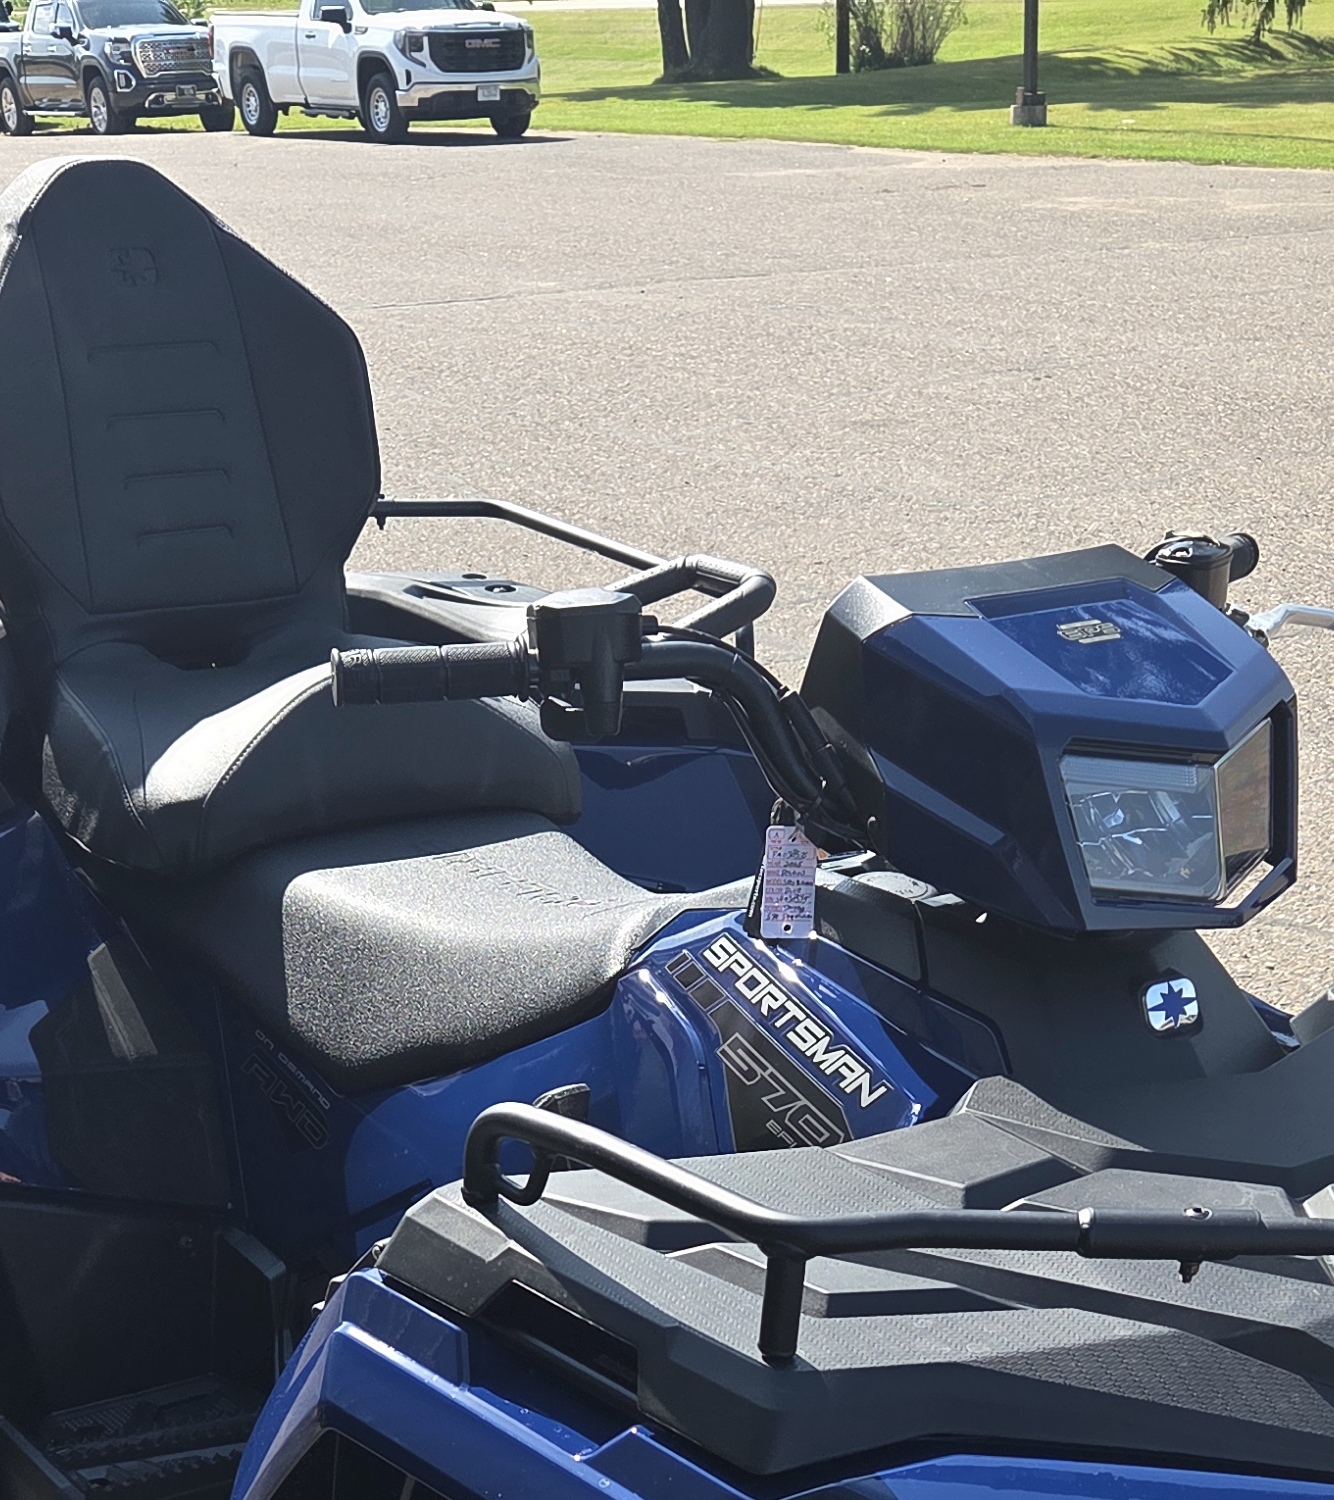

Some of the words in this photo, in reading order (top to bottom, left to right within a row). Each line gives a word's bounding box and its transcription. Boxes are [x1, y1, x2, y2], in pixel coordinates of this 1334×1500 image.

[465, 38, 501, 48] GMC
[702, 936, 888, 1108] SPORTSMAN
[240, 1052, 329, 1150] AWD
[716, 1031, 846, 1148] 570
[766, 1119, 798, 1149] EFI
